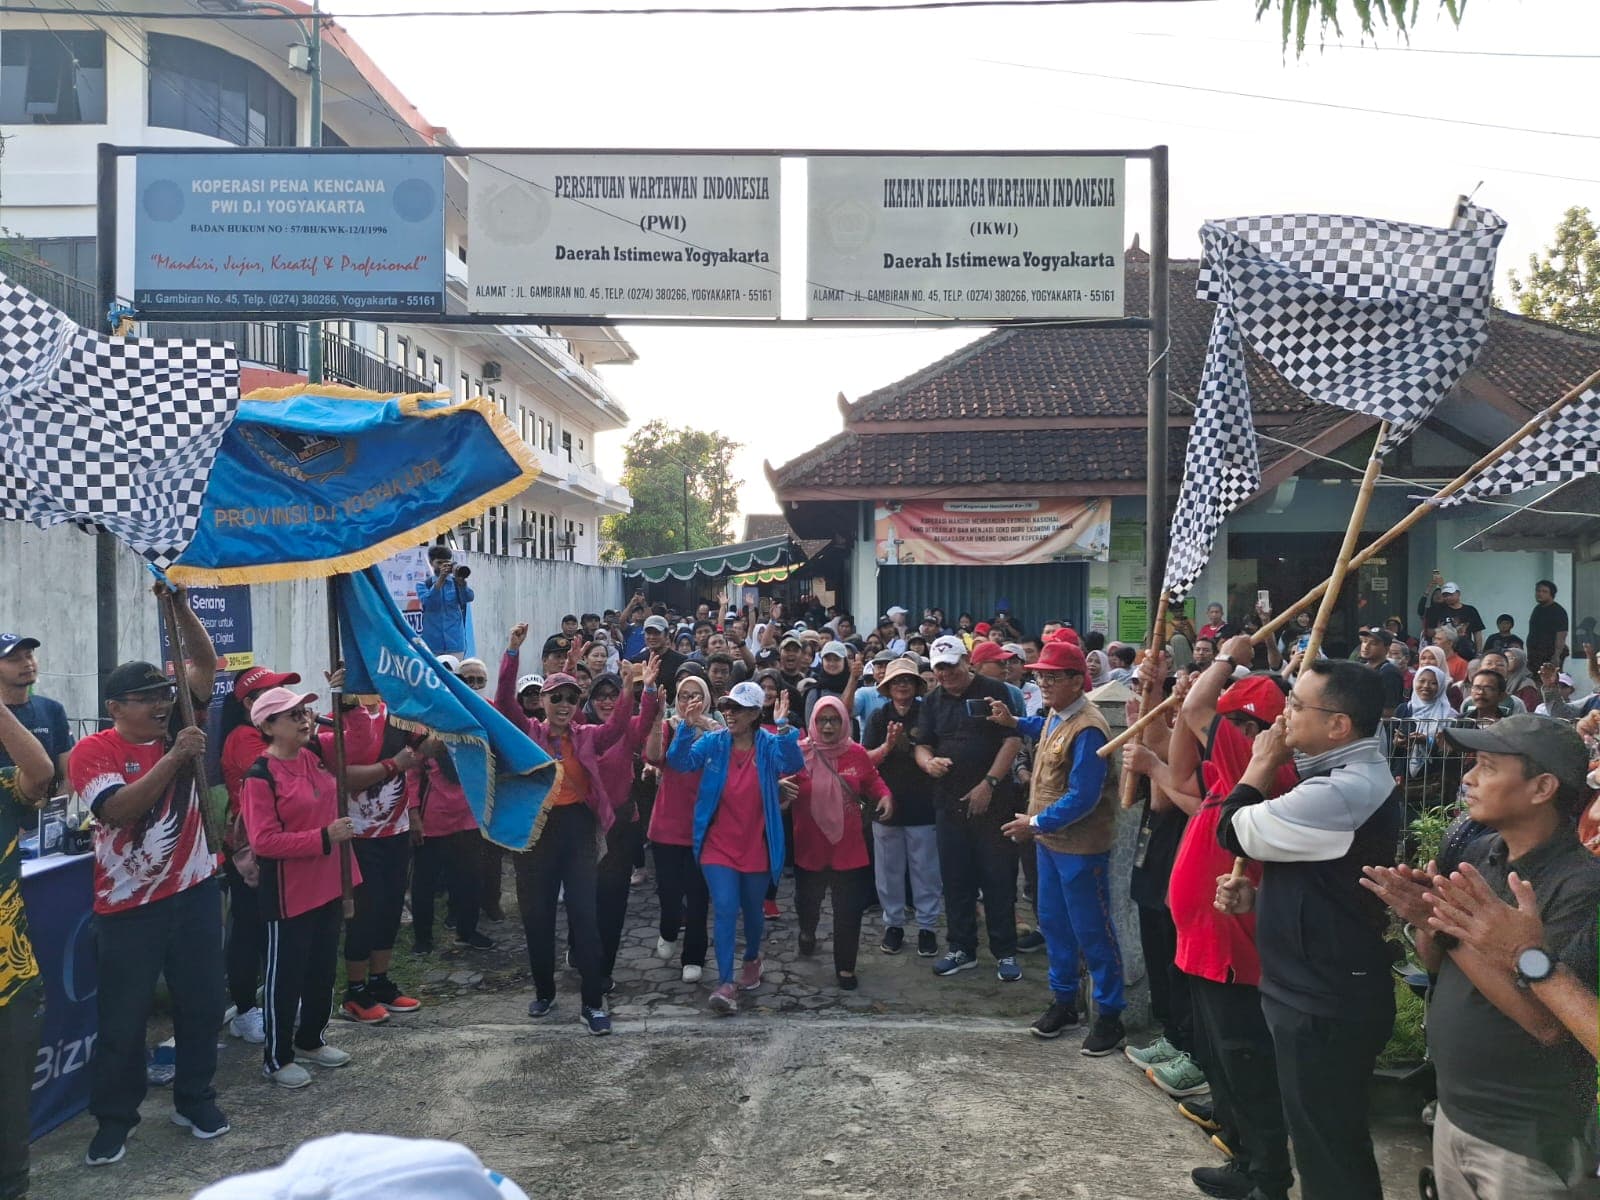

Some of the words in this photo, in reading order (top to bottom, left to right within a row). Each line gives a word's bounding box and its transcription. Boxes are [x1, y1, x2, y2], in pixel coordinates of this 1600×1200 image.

[191, 179, 265, 194] KOPERASI
[269, 179, 309, 194] PENA
[314, 179, 386, 194] KENCANA
[554, 175, 625, 200] PERSATUAN
[628, 175, 698, 200] WARTAWAN
[703, 176, 770, 200] INDONESIA
[883, 178, 925, 208] IKATAN
[926, 178, 985, 208] KELUARGA
[987, 178, 1050, 207] WARTAWAN
[1053, 177, 1115, 207] INDONESIA
[211, 199, 238, 214] PWI
[243, 200, 261, 214] D.I
[265, 199, 366, 215] YOGYAKARTA
[190, 224, 225, 234] BADAN
[227, 224, 265, 234] HUKUM
[267, 224, 283, 234] NO
[639, 215, 687, 233] (PWI)
[969, 221, 1019, 238] (IKWI)
[555, 245, 610, 262] Daerah
[613, 246, 683, 263] Istimewa
[685, 247, 770, 267] Yogyakarta
[883, 253, 942, 269] Daerah
[945, 251, 1021, 269] Istimewa
[1023, 251, 1115, 272] Yogyakarta
[223, 255, 264, 278] Jujur,
[270, 253, 319, 277] Kreatif
[322, 255, 334, 270] &
[141, 293, 153, 304] Jl.
[155, 294, 203, 305] Gambiran
[206, 294, 223, 305] No.
[243, 293, 266, 306] Telp.
[268, 293, 300, 307] (0274)
[301, 295, 339, 307] 380266,
[342, 295, 397, 308] Yogyakarta
[406, 296, 436, 306] 55161
[475, 285, 507, 298] ALAMAT
[529, 286, 571, 299] GAMBIRAN
[573, 287, 587, 299] NO.
[604, 287, 625, 300] TELP.
[627, 287, 654, 301] (0274)
[655, 288, 689, 302] 380266,
[691, 288, 741, 302] YOGYAKARTA
[748, 289, 772, 302] 55161
[813, 289, 845, 302] ALAMAT
[867, 290, 910, 302] GAMBIRAN
[911, 290, 926, 302] NO.
[928, 290, 941, 303] 45,
[966, 289, 993, 302] (0274)
[995, 289, 1029, 303] 380266,
[1031, 290, 1082, 302] YOGYAKARTA
[1090, 290, 1115, 302] 55161
[214, 506, 308, 528] PROVINSI
[343, 458, 442, 515] YOGYAKARTA
